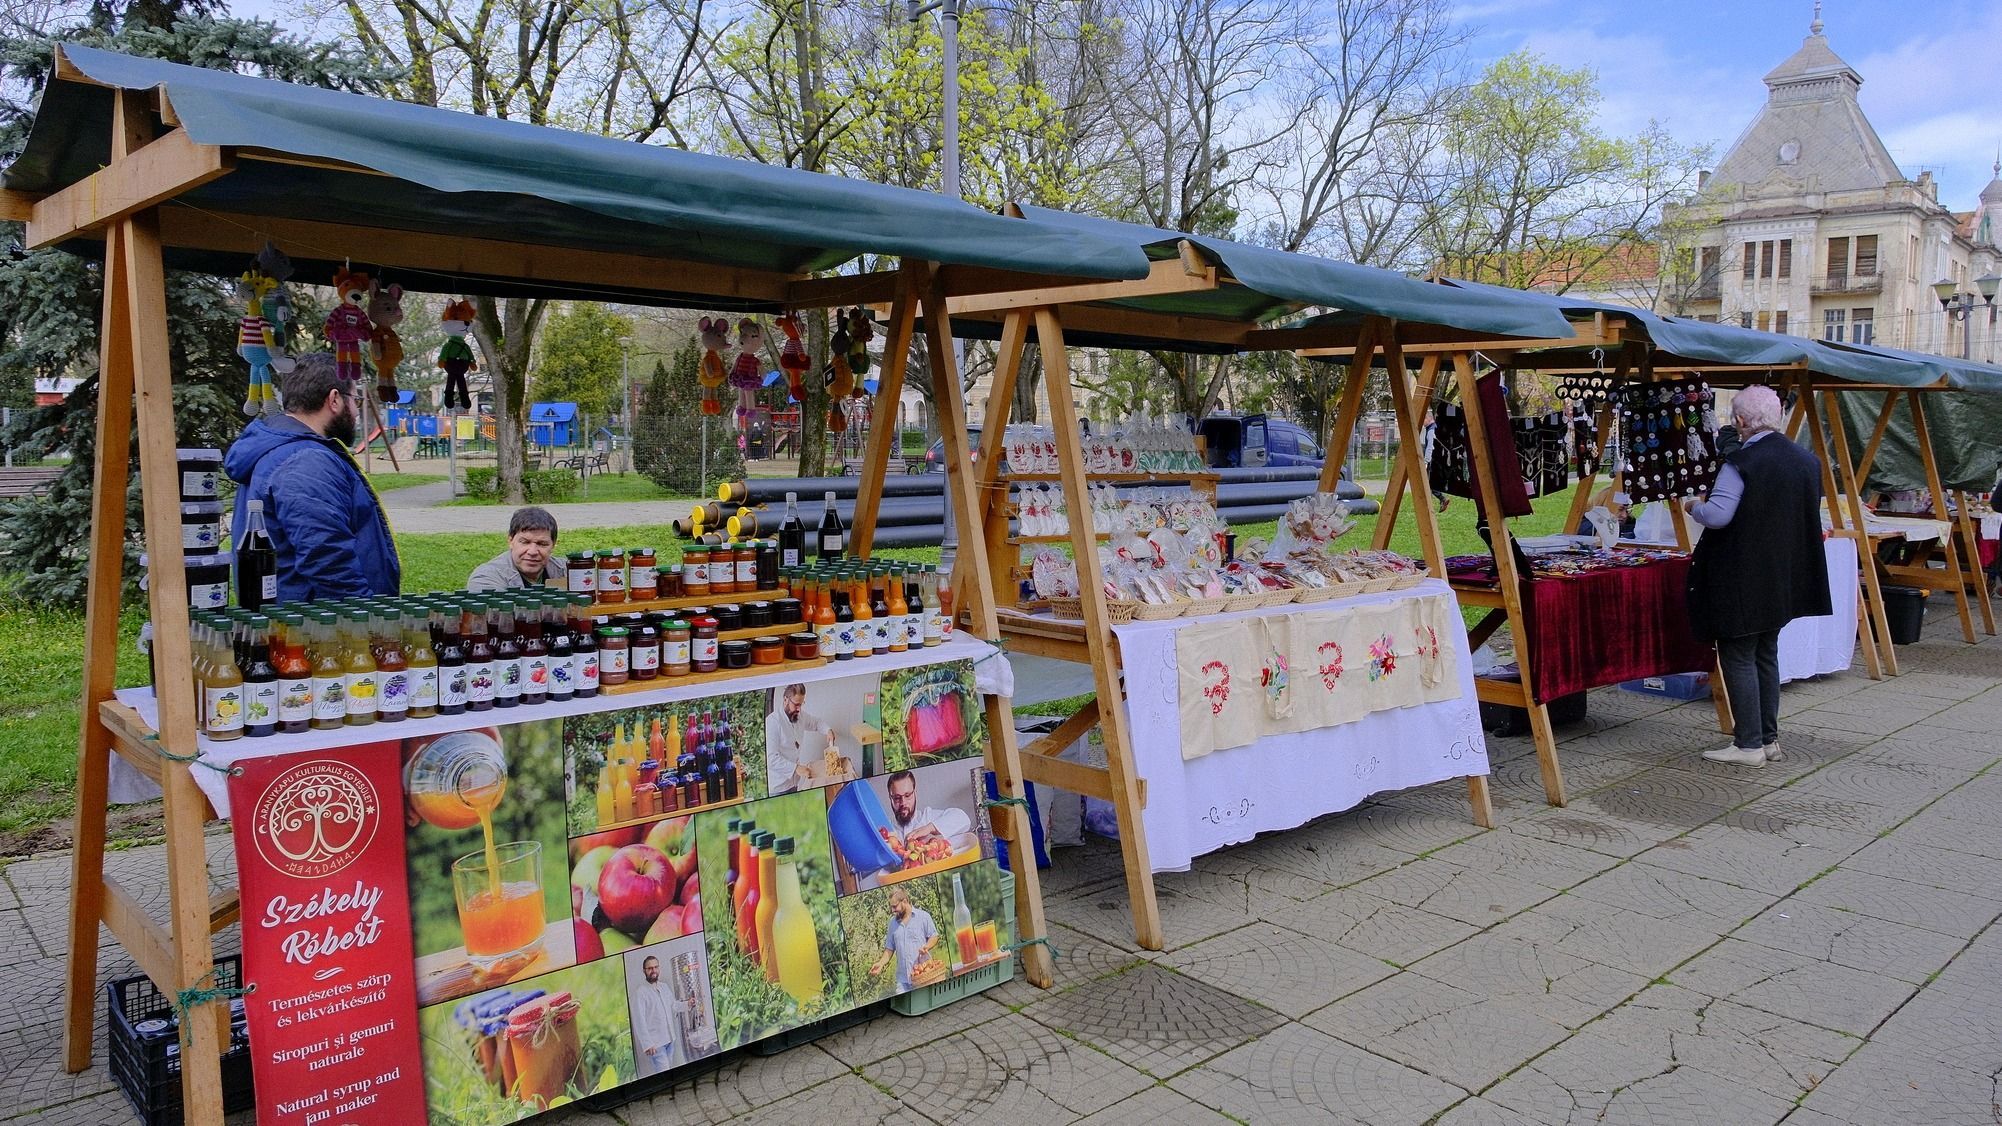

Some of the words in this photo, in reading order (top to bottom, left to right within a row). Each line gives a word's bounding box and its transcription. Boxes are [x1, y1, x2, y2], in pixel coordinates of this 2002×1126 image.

[260, 776, 295, 819] ARANYKAPU
[294, 764, 343, 780] KULTURÁLIS
[342, 770, 374, 804] EGYESÜLET
[262, 881, 383, 927] Székely
[282, 916, 384, 964] Róbert
[268, 984, 352, 1011] Természetes
[357, 974, 391, 989] szörp
[277, 1016, 291, 1027] és
[298, 988, 386, 1022] lekvárkészítő
[273, 1038, 329, 1064] Siropuri
[350, 1019, 395, 1045] gemuri
[309, 1047, 364, 1070] naturale
[276, 1089, 328, 1116] Natural
[333, 1080, 371, 1100] syrup
[376, 1067, 400, 1084] and
[305, 1110, 330, 1126] jam
[336, 1094, 377, 1115] maker
